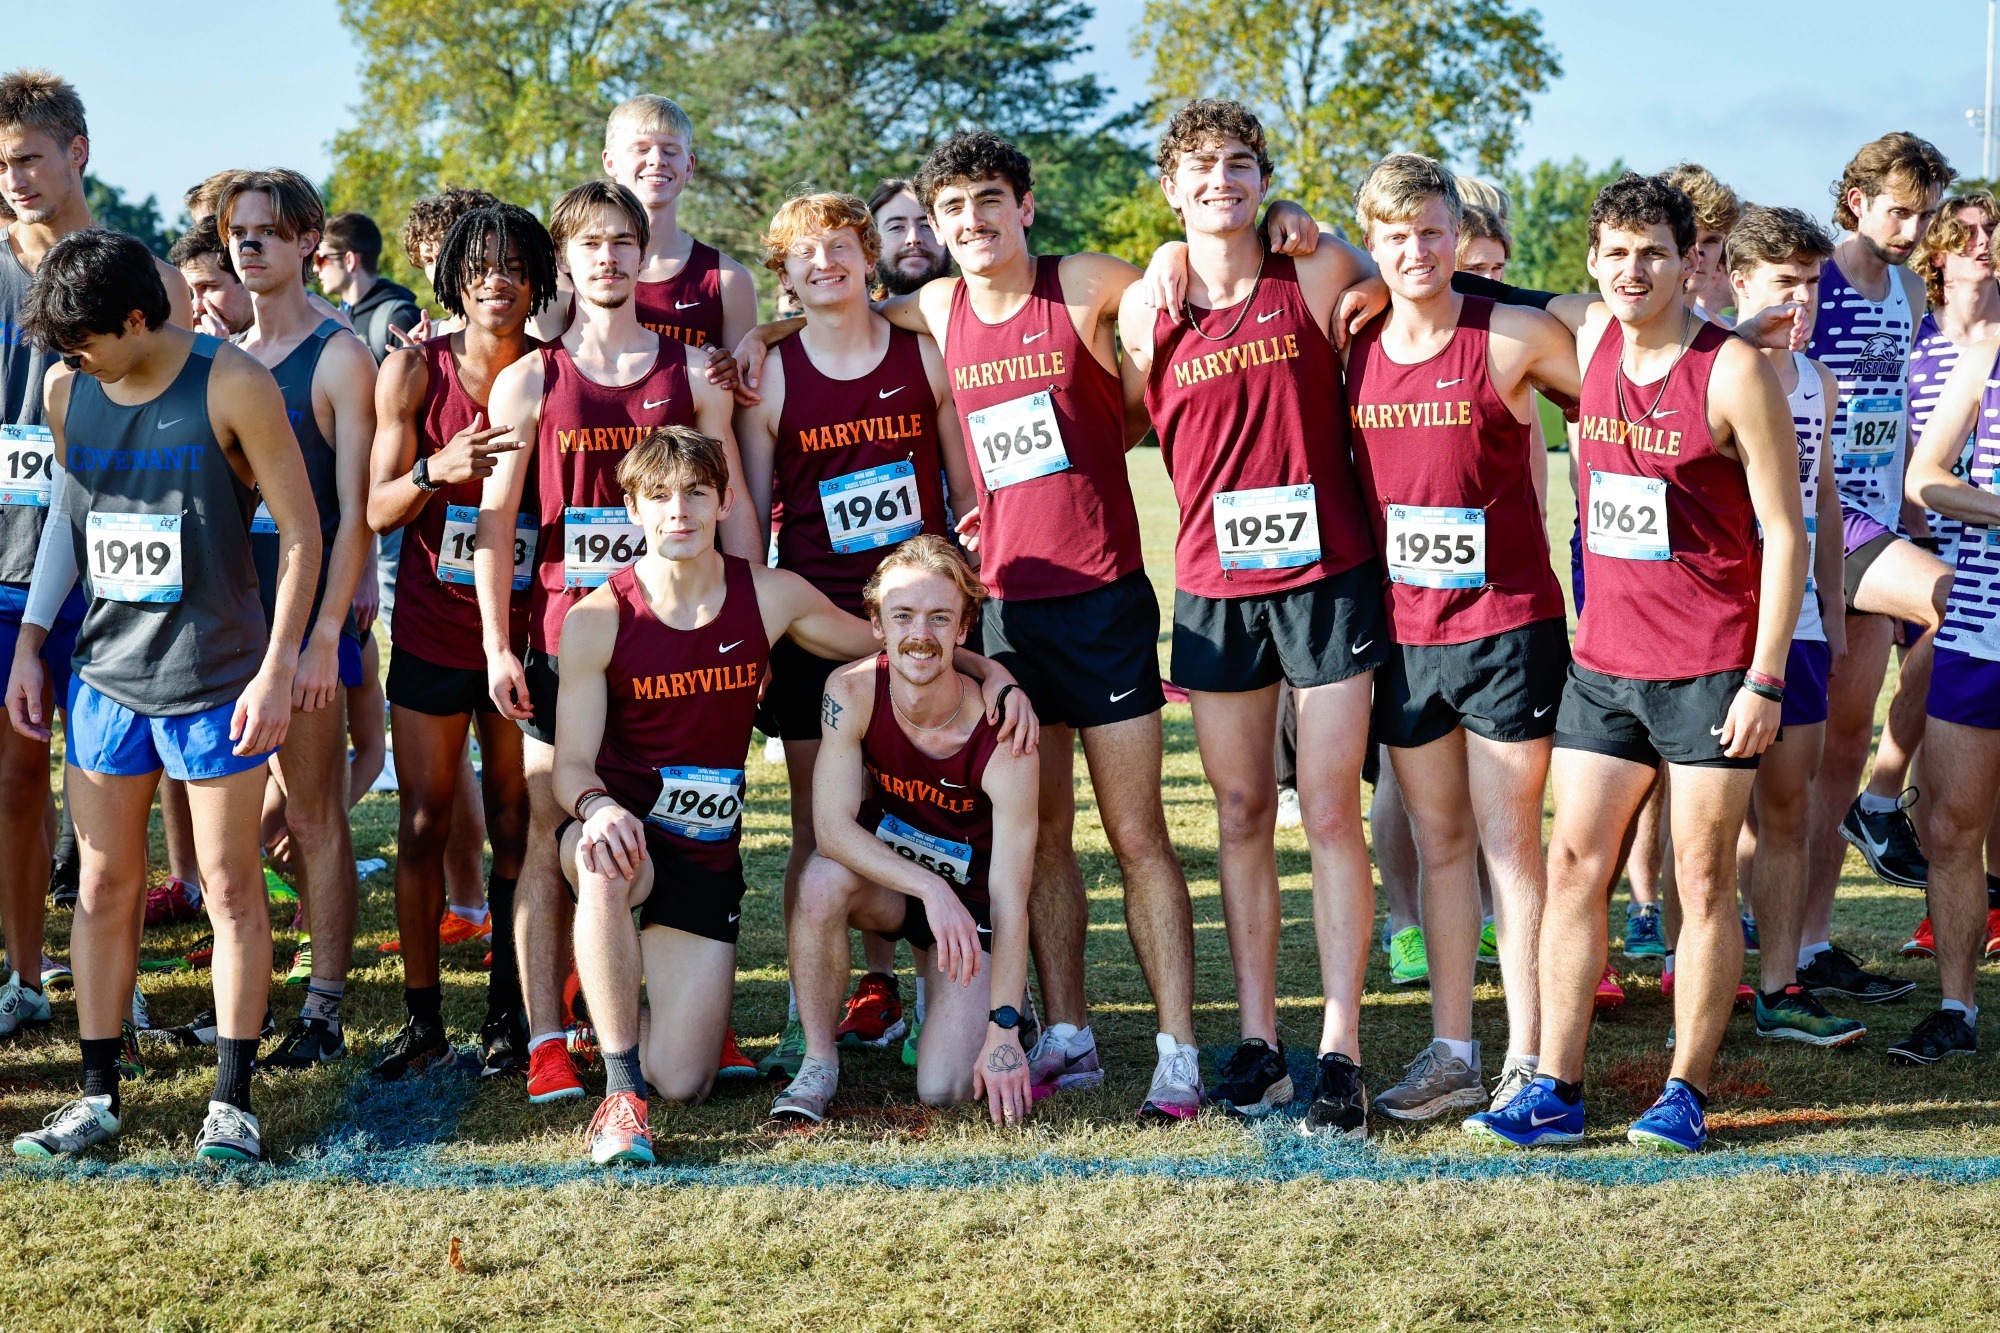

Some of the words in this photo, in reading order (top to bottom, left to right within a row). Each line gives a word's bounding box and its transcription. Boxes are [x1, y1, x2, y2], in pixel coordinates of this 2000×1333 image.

[954, 350, 1066, 391] MARYVILLE
[1173, 333, 1300, 388] MARYVILLE
[1849, 360, 1904, 376] ASBURY
[1350, 401, 1471, 428] MARYVILLE
[799, 413, 922, 453] MARYVILLE
[983, 419, 1052, 463] 1965
[1581, 415, 1682, 456] MARYVILLE
[1854, 420, 1897, 446] 1874
[68, 445, 204, 472] COVENANT
[834, 485, 912, 531] 1961
[1594, 500, 1657, 534] 1962
[1225, 512, 1308, 546] 1957
[95, 540, 171, 575] 1919
[574, 534, 648, 562] 1964
[1396, 532, 1475, 564] 1955
[632, 662, 757, 701] MARYVILLE
[667, 789, 738, 819] 1960
